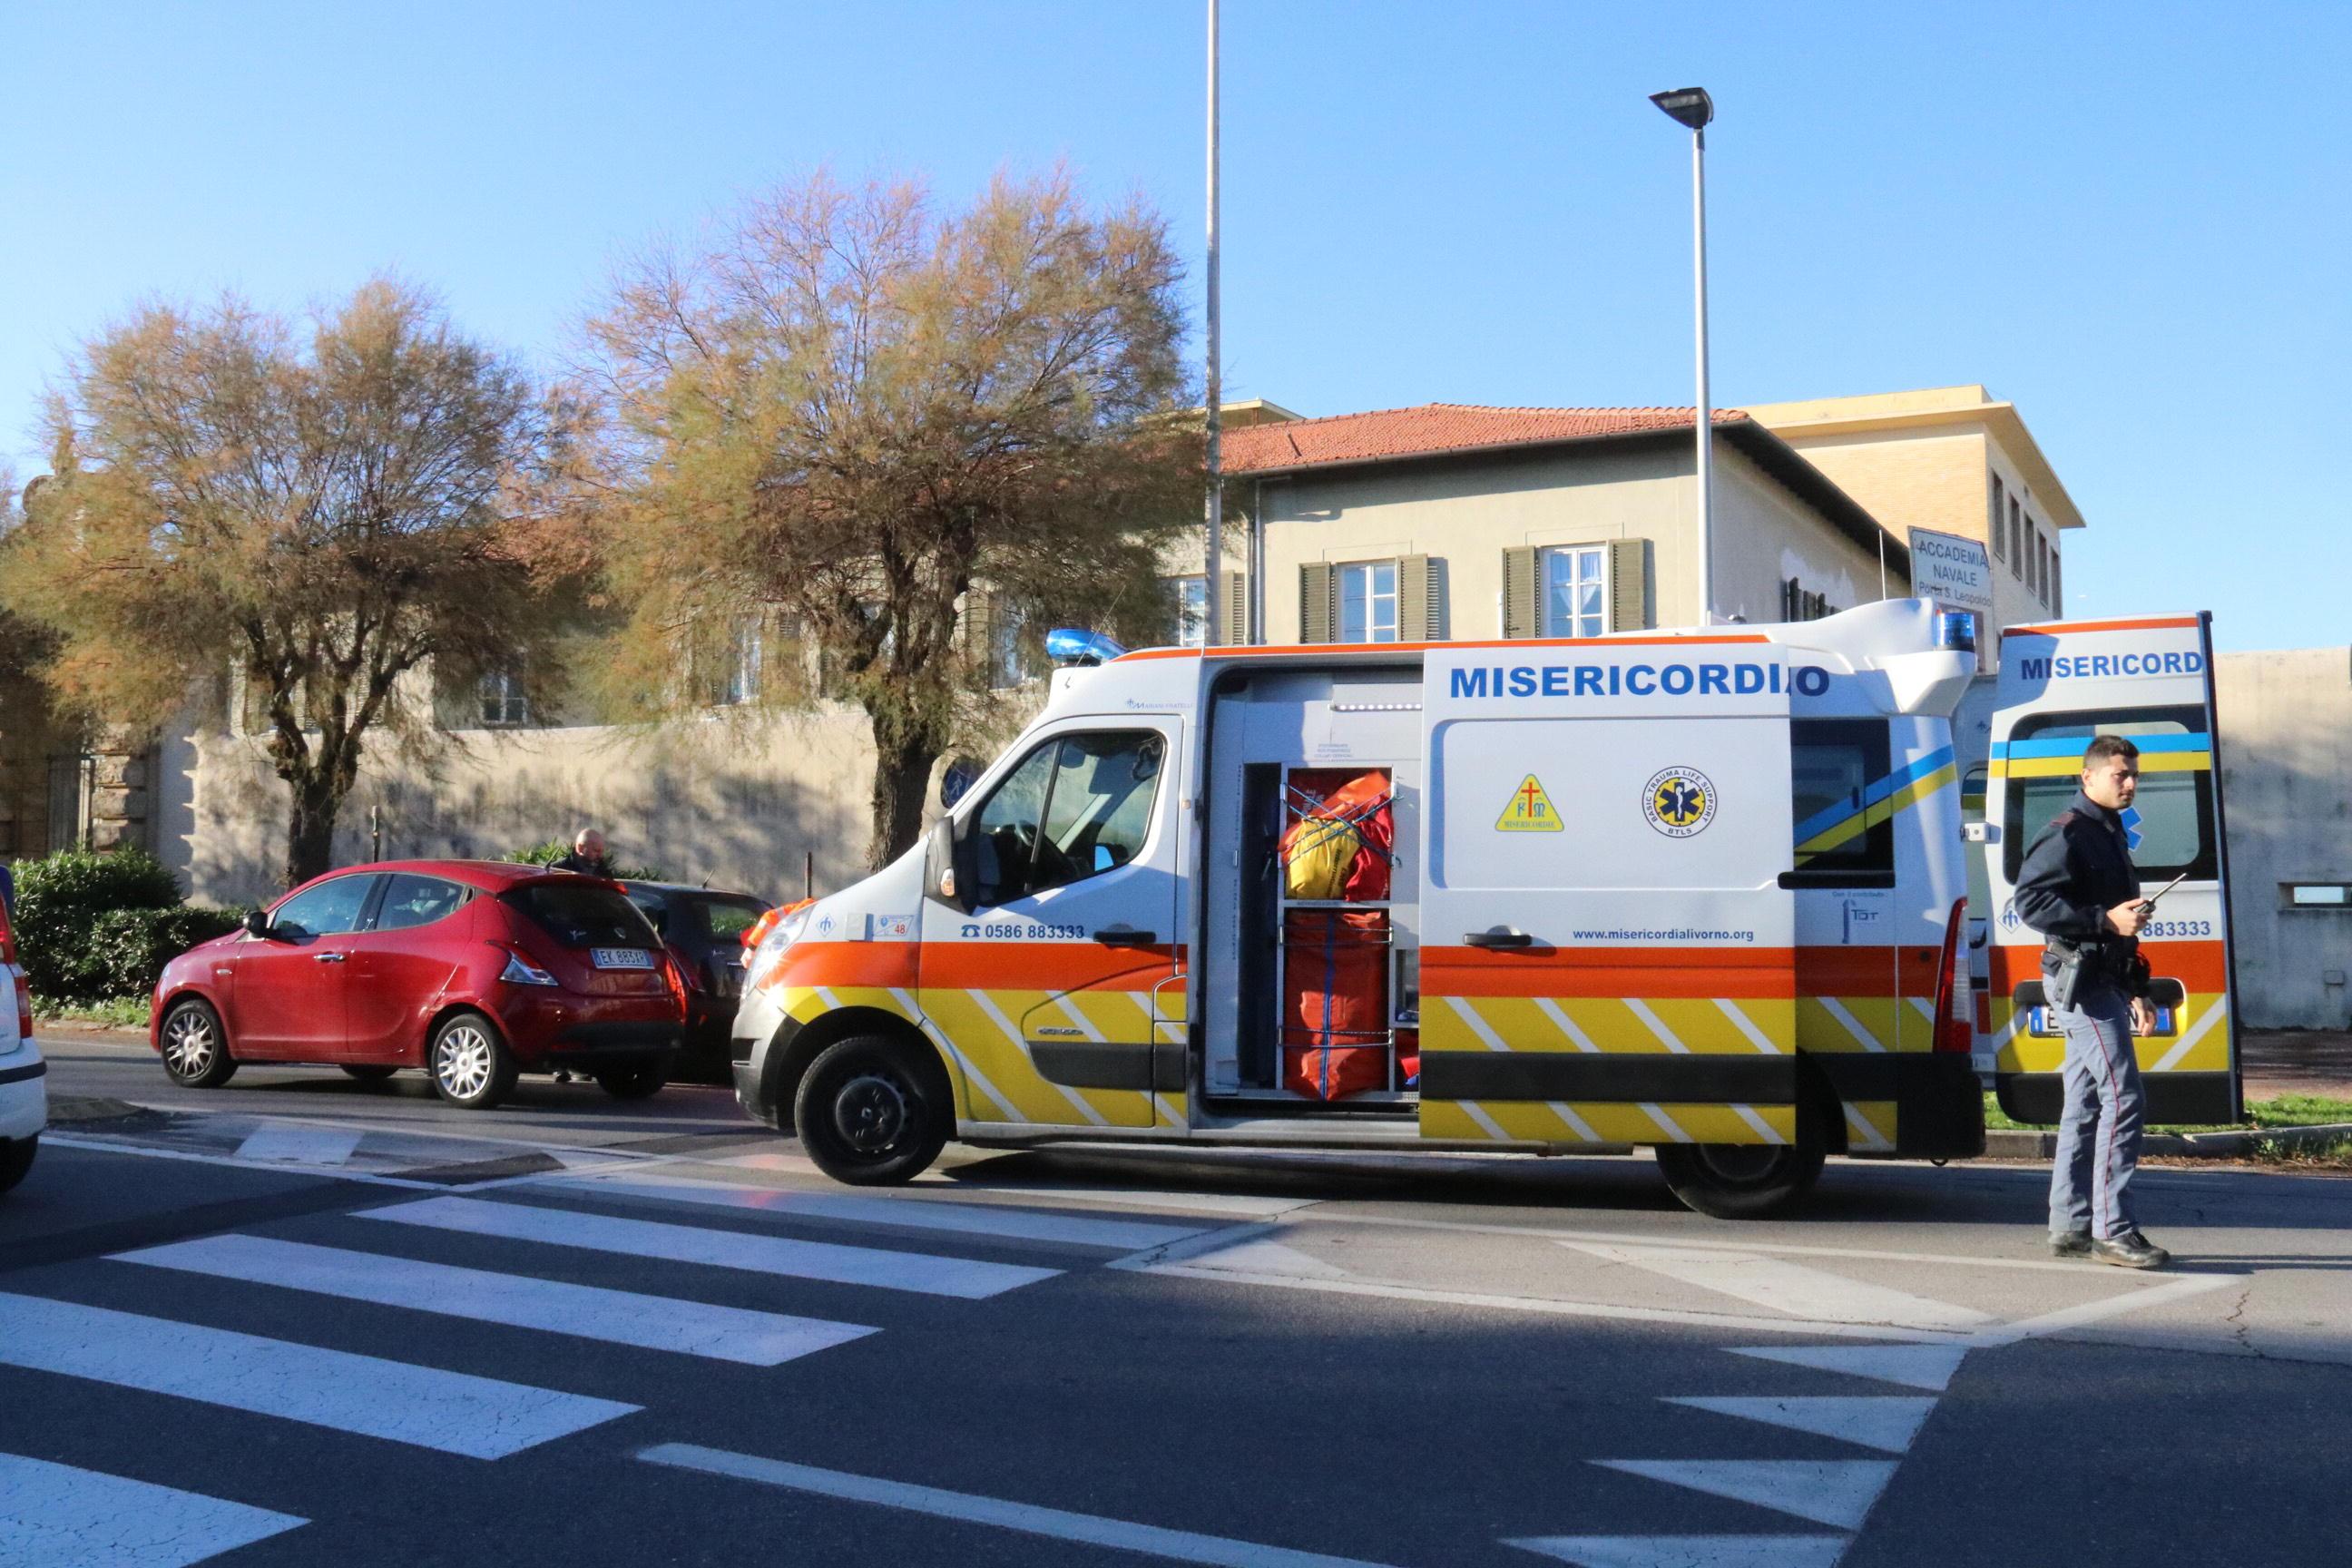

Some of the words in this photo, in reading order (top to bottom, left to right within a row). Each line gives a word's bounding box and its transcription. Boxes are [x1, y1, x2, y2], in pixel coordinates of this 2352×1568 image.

[1916, 540, 1989, 568] ACCADEMIA
[1933, 564, 1977, 586] NAVALE
[1648, 769, 1680, 793] TRAUMA
[1682, 769, 1703, 781] LIFE
[1646, 796, 1658, 822] BASIC
[1700, 781, 1714, 822] SUPPORT
[895, 924, 906, 935] 48
[985, 925, 1023, 938] 0586
[1027, 925, 1085, 939] 883333
[1573, 928, 1754, 942] www.misericordialivorno.org
[2142, 920, 2211, 936] 883333
